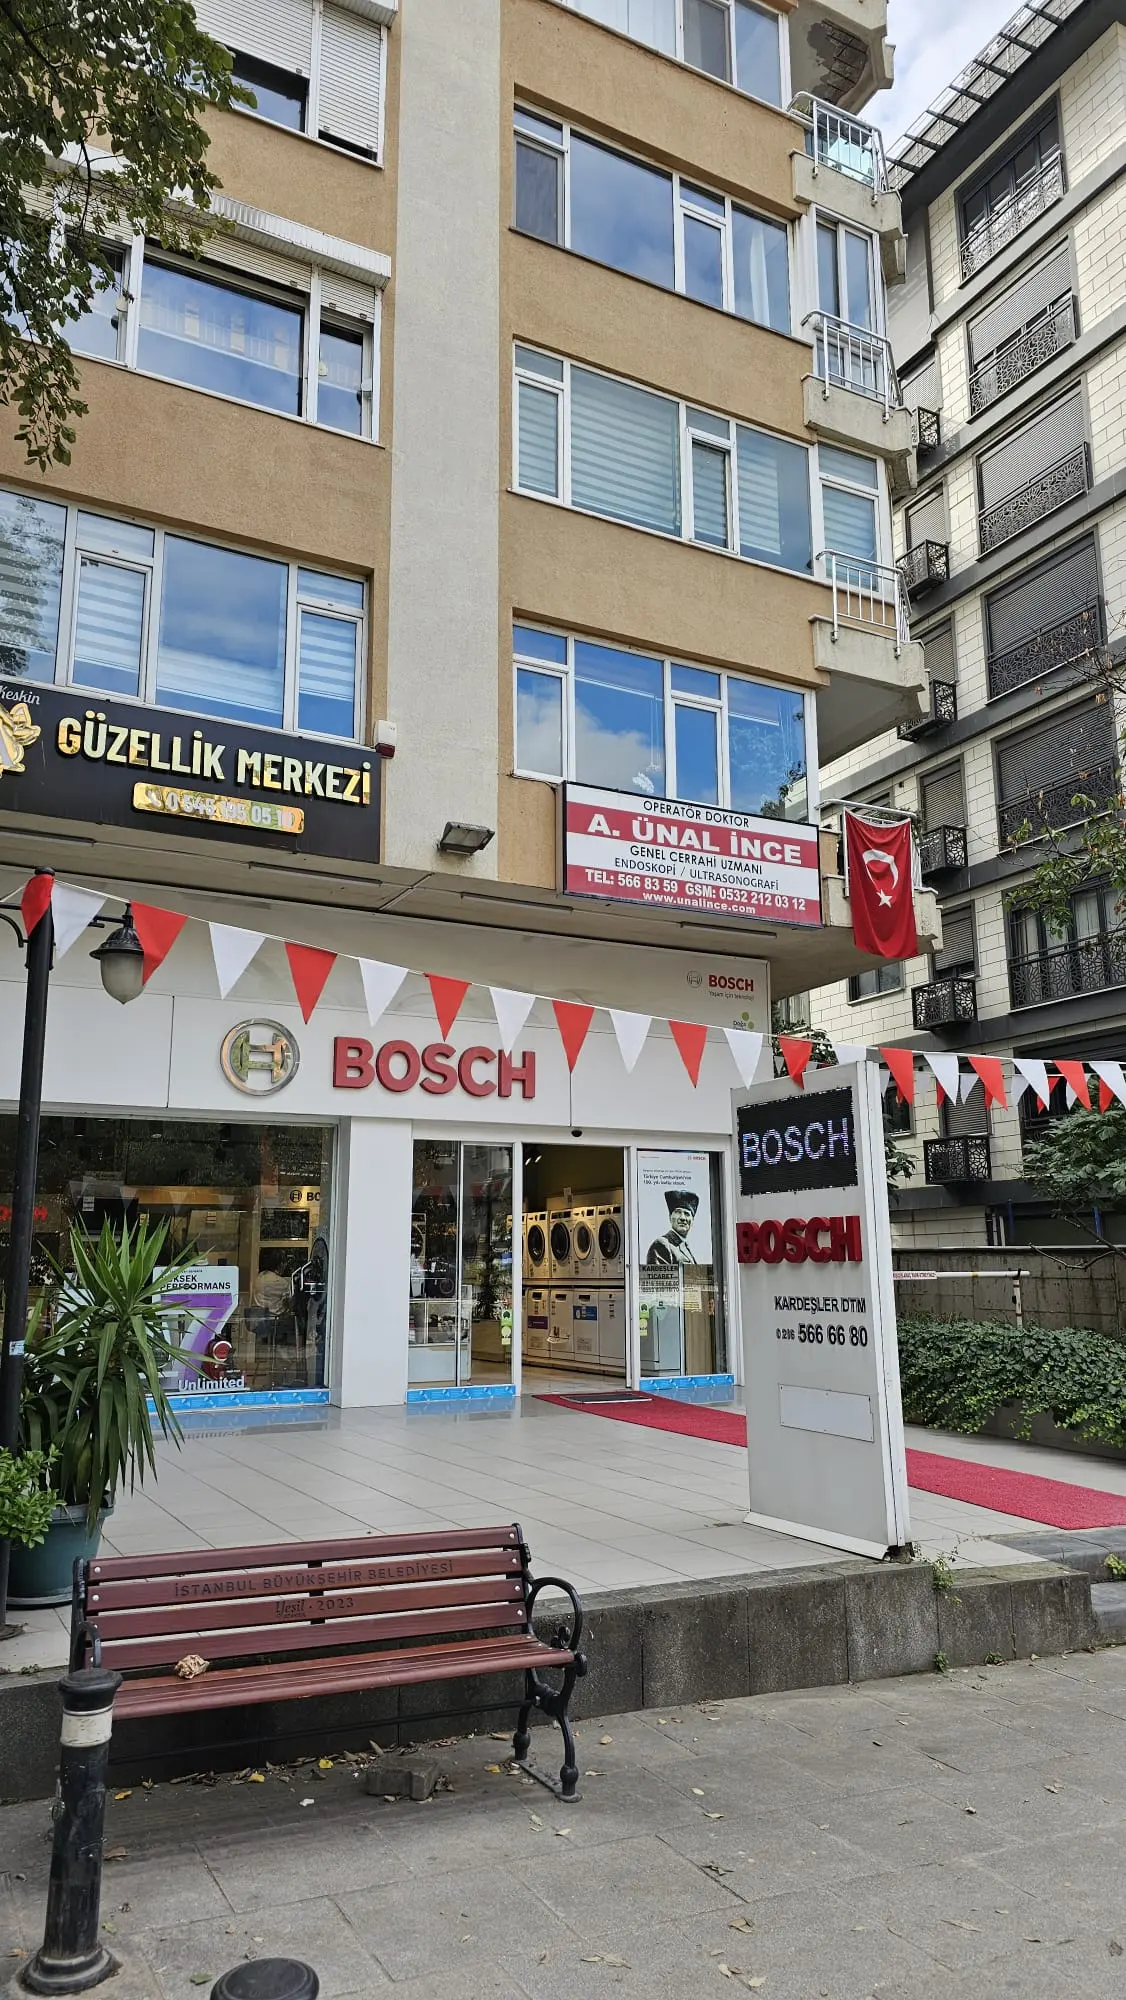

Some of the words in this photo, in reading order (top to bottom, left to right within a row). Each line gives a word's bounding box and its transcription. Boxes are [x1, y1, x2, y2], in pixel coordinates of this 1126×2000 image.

[58, 710, 225, 780] GÜZELLİK
[237, 748, 371, 805] MERKEZİ
[183, 794, 216, 816] 545
[251, 804, 272, 825] 05
[643, 801, 702, 820] OPERATÖR
[705, 811, 750, 828] DOKTOR
[587, 813, 620, 836] A.
[632, 817, 720, 853] ÜNAL
[730, 831, 802, 864] İNCE
[615, 857, 676, 876] ENDOSKOPİ
[690, 867, 779, 891] ULTRASONOGRAFİ
[630, 845, 666, 861] GENEL
[669, 851, 717, 868] CERRAHİ
[721, 859, 763, 875] UZMANI
[585, 868, 615, 885] TEL:
[617, 874, 641, 889] 566
[644, 878, 660, 892] 83
[663, 880, 678, 894] 59
[685, 883, 716, 899] GSM:
[719, 888, 748, 903] 0532
[751, 893, 772, 907] 212
[775, 896, 791, 909] 03
[793, 898, 806, 911] 12
[643, 892, 756, 914] www.unalince.com
[708, 974, 754, 992] BOSCH
[333, 1036, 536, 1099] BOSCH
[743, 1117, 850, 1167] BOSCH
[736, 1216, 862, 1263] BOSCH
[774, 1296, 839, 1314] KARDEŞLER
[840, 1297, 866, 1312] DTM
[798, 1323, 823, 1344] 566
[827, 1324, 845, 1345] 66
[849, 1325, 868, 1347] 80
[178, 1375, 245, 1391] Unlimited
[174, 1580, 256, 1597] İSTANBUL
[262, 1570, 363, 1590] BÜYÜKŞEHİR
[368, 1559, 454, 1582] BELEDİYESİ
[317, 1597, 354, 1611] 2023
